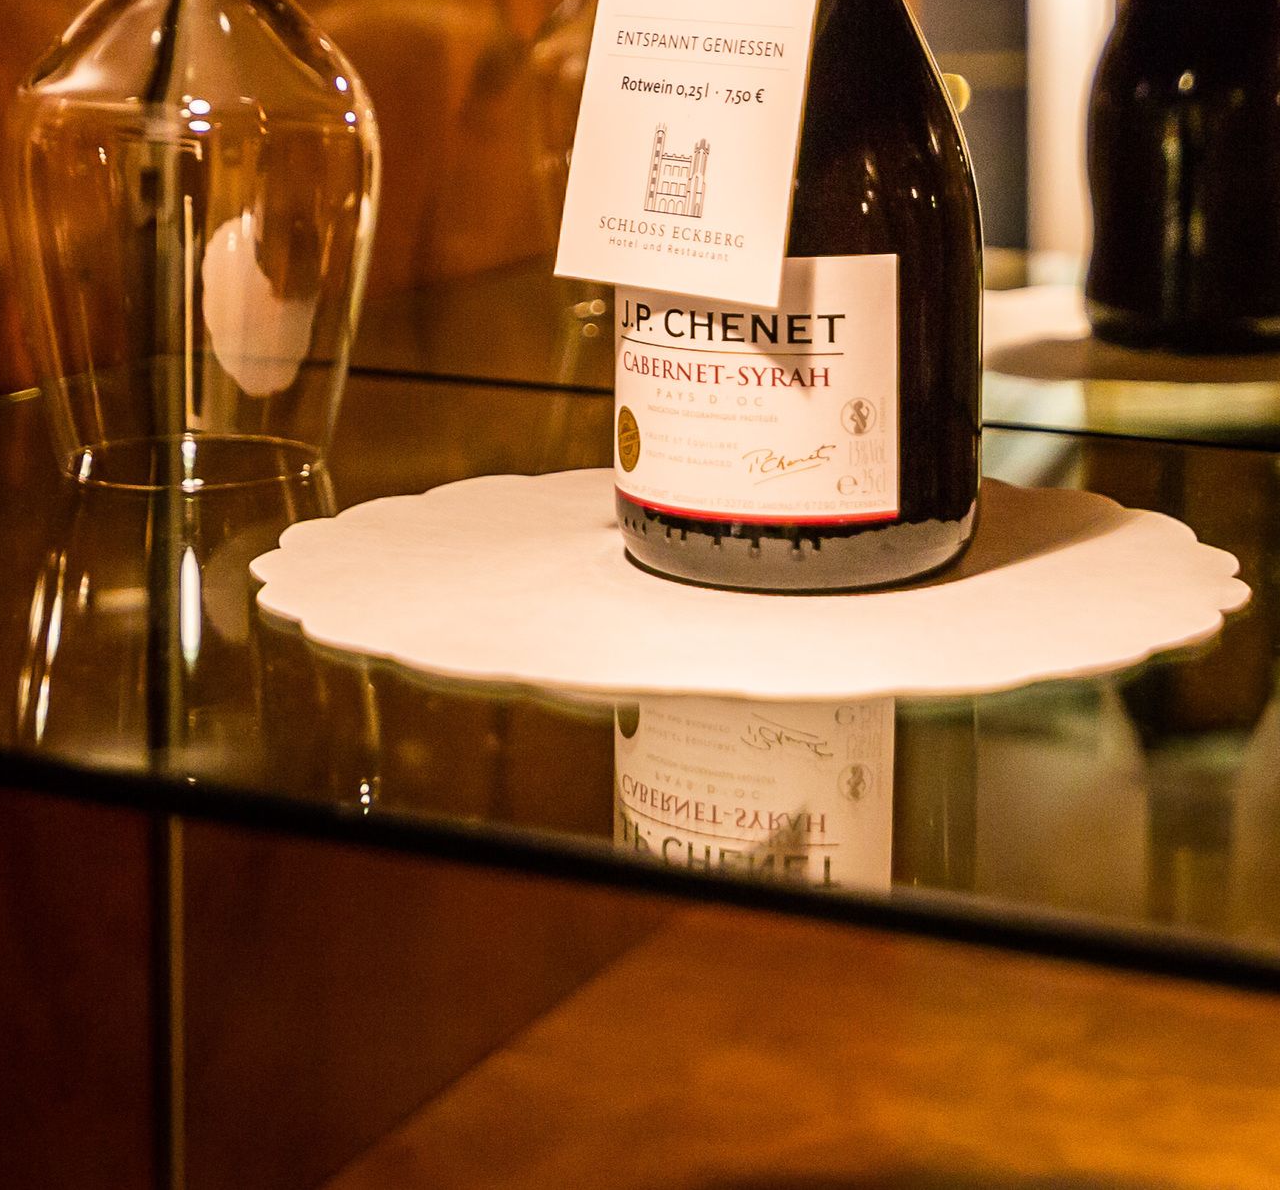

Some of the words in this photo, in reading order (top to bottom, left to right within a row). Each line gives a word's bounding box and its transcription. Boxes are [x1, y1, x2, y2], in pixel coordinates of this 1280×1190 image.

[616, 29, 699, 51] ENTSPANNT
[702, 37, 785, 58] GENIESSEN
[621, 76, 673, 95] Rotwein
[724, 89, 751, 105] 7,50
[755, 88, 765, 103] €
[598, 216, 666, 237] SCHLOSS
[671, 226, 745, 248] ECKBERG
[608, 236, 638, 248] Hotel
[642, 242, 662, 252] und
[667, 244, 729, 262] Restaurant
[621, 300, 653, 332] J.P.
[664, 308, 846, 345] CHENET
[623, 351, 831, 388] CABERNET-SYRAH
[656, 388, 695, 403] PAYS
